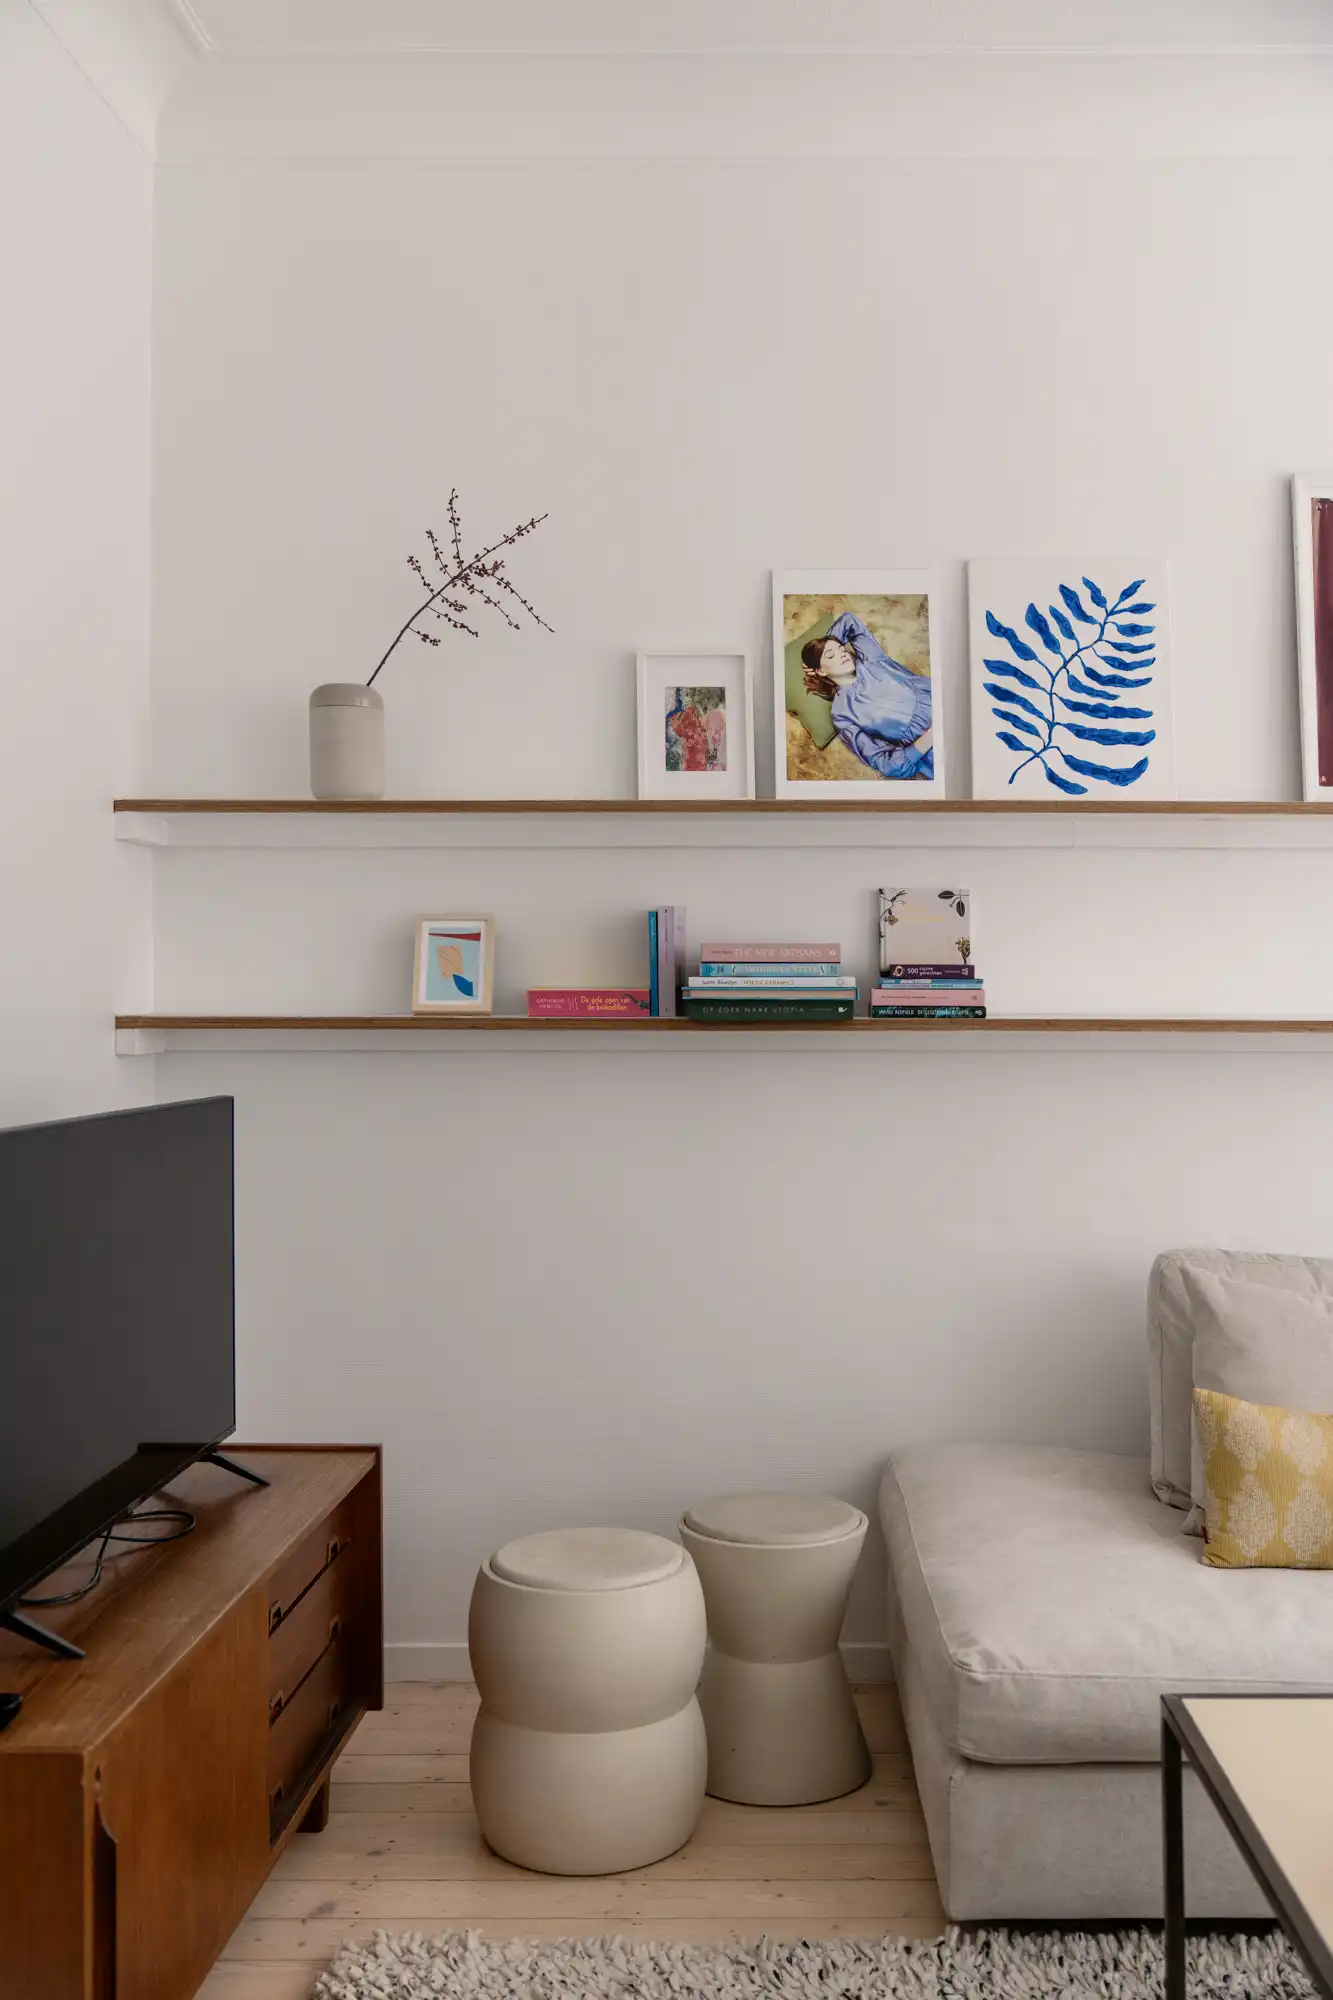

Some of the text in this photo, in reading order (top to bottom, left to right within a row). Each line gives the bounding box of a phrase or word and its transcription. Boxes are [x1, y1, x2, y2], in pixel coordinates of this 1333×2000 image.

[734, 948, 753, 957] THE
[754, 948, 776, 957] NEW
[778, 947, 822, 957] ARTISANS
[907, 967, 919, 975] 500
[586, 1003, 595, 1011] de
